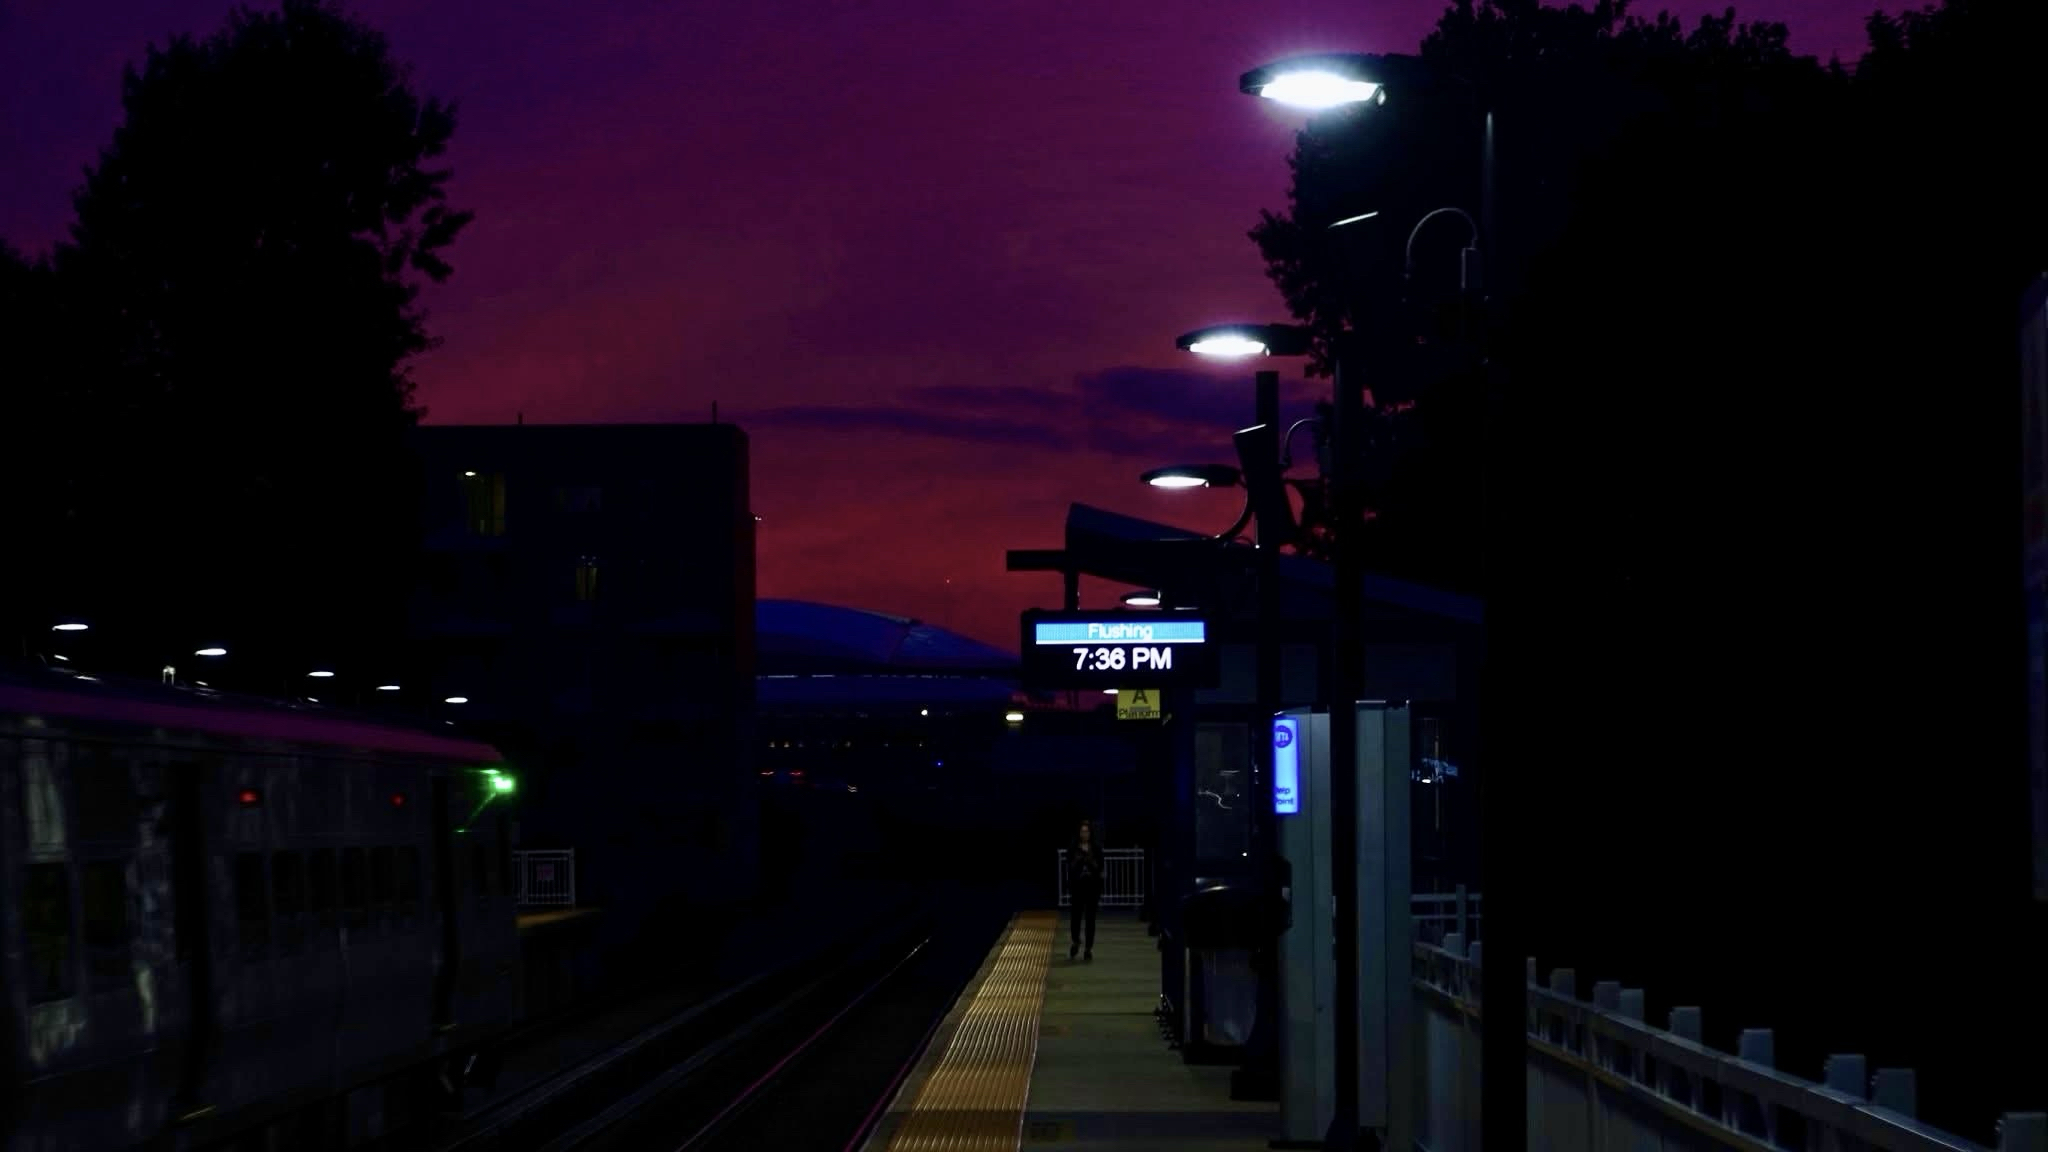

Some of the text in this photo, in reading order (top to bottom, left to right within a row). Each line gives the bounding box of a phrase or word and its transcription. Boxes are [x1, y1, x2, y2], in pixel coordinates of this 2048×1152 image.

[1088, 623, 1152, 640] Flushing
[1073, 647, 1172, 670] 7:36 PM
[1132, 688, 1148, 704] A
